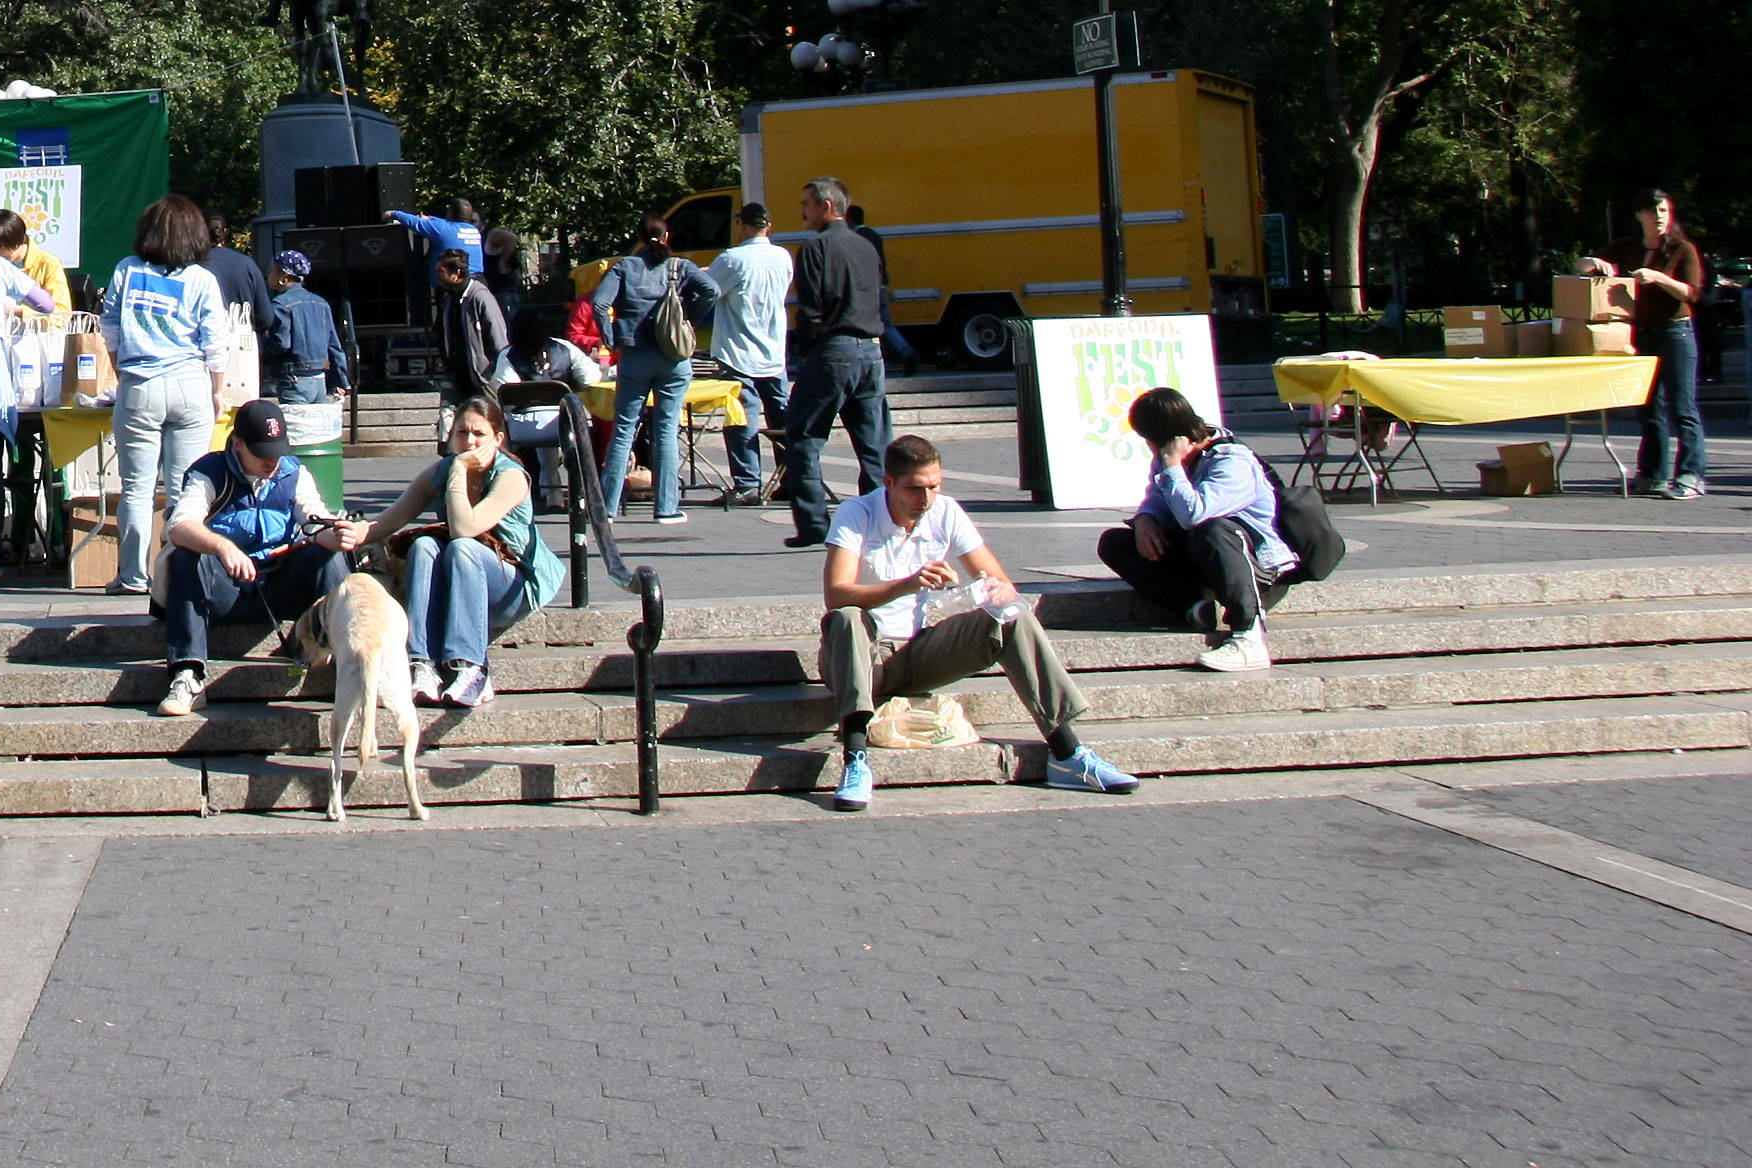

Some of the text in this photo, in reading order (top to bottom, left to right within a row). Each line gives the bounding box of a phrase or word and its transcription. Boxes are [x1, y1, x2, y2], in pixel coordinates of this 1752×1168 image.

[1081, 22, 1100, 44] NO
[5, 168, 65, 179] DAFFODIL
[4, 178, 65, 218] FEST
[34, 219, 60, 244] 06
[1071, 319, 1180, 339] DAFFODIL
[1073, 339, 1183, 420] FEST
